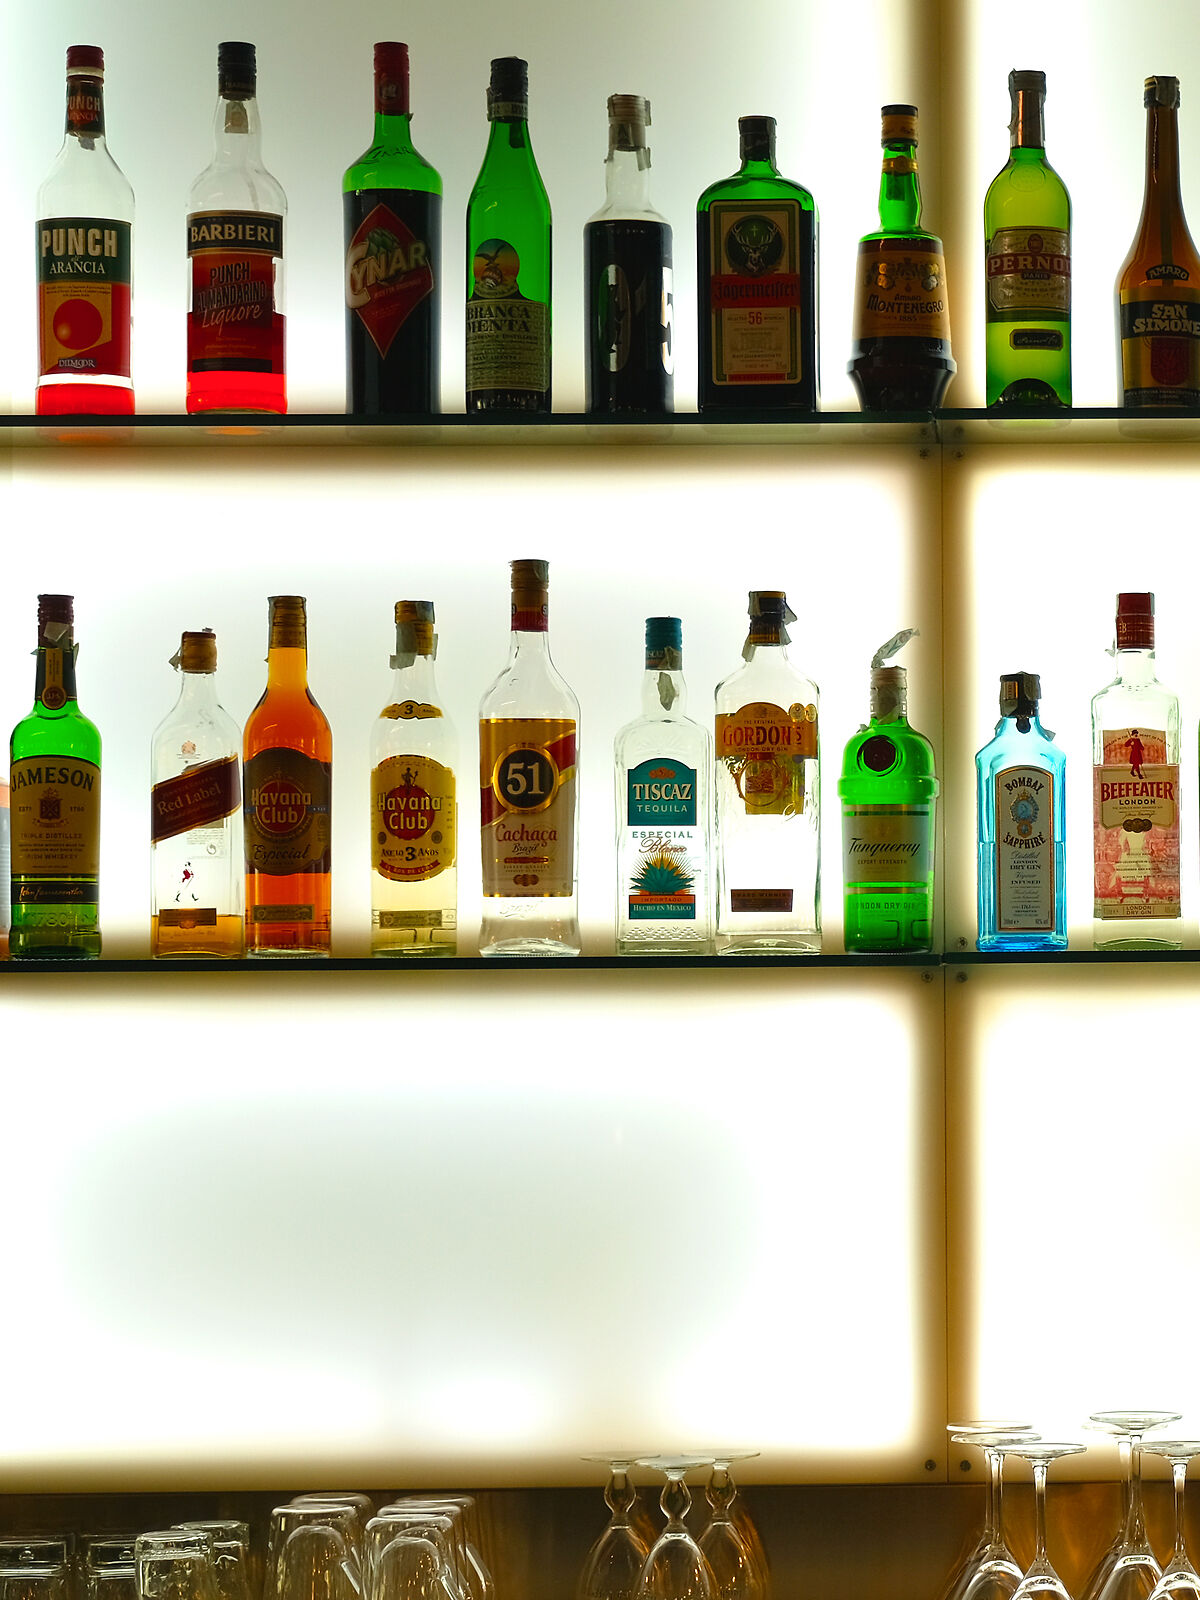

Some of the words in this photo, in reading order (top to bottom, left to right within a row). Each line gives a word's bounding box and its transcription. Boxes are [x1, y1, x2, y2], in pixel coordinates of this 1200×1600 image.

[190, 223, 275, 243] BARBIERI
[41, 227, 118, 258] PUNCH
[49, 260, 106, 274] ARANCIA
[210, 260, 250, 287] PUNCH
[345, 239, 427, 309] CYNAR
[1149, 265, 1188, 280] AMARO
[466, 304, 531, 320] BRANCA
[867, 294, 944, 313] MONTENEGRO
[1151, 303, 1189, 320] SAN
[201, 303, 263, 336] Liquore
[748, 311, 763, 325] 56
[405, 704, 414, 715] 3
[11, 766, 95, 793] JAMESON
[506, 762, 545, 795] 51
[1004, 776, 1045, 793] BOMBAY
[157, 795, 184, 816] Red
[185, 781, 222, 805] Label
[251, 788, 313, 806] Havana
[632, 783, 692, 801] TISCAZ
[1100, 781, 1175, 802] BEEFEATER
[377, 792, 442, 811] Havana
[636, 804, 688, 813] TEQUILA
[261, 806, 298, 824] Club
[389, 811, 429, 830] Club
[495, 823, 558, 848] Cachaça
[632, 831, 693, 839] ESPECIAL
[1003, 832, 1047, 850] SAPPHIRE
[252, 844, 311, 864] Especial
[405, 846, 416, 862] 3
[638, 836, 687, 854] Blanco
[849, 837, 921, 857] Tanqueray
